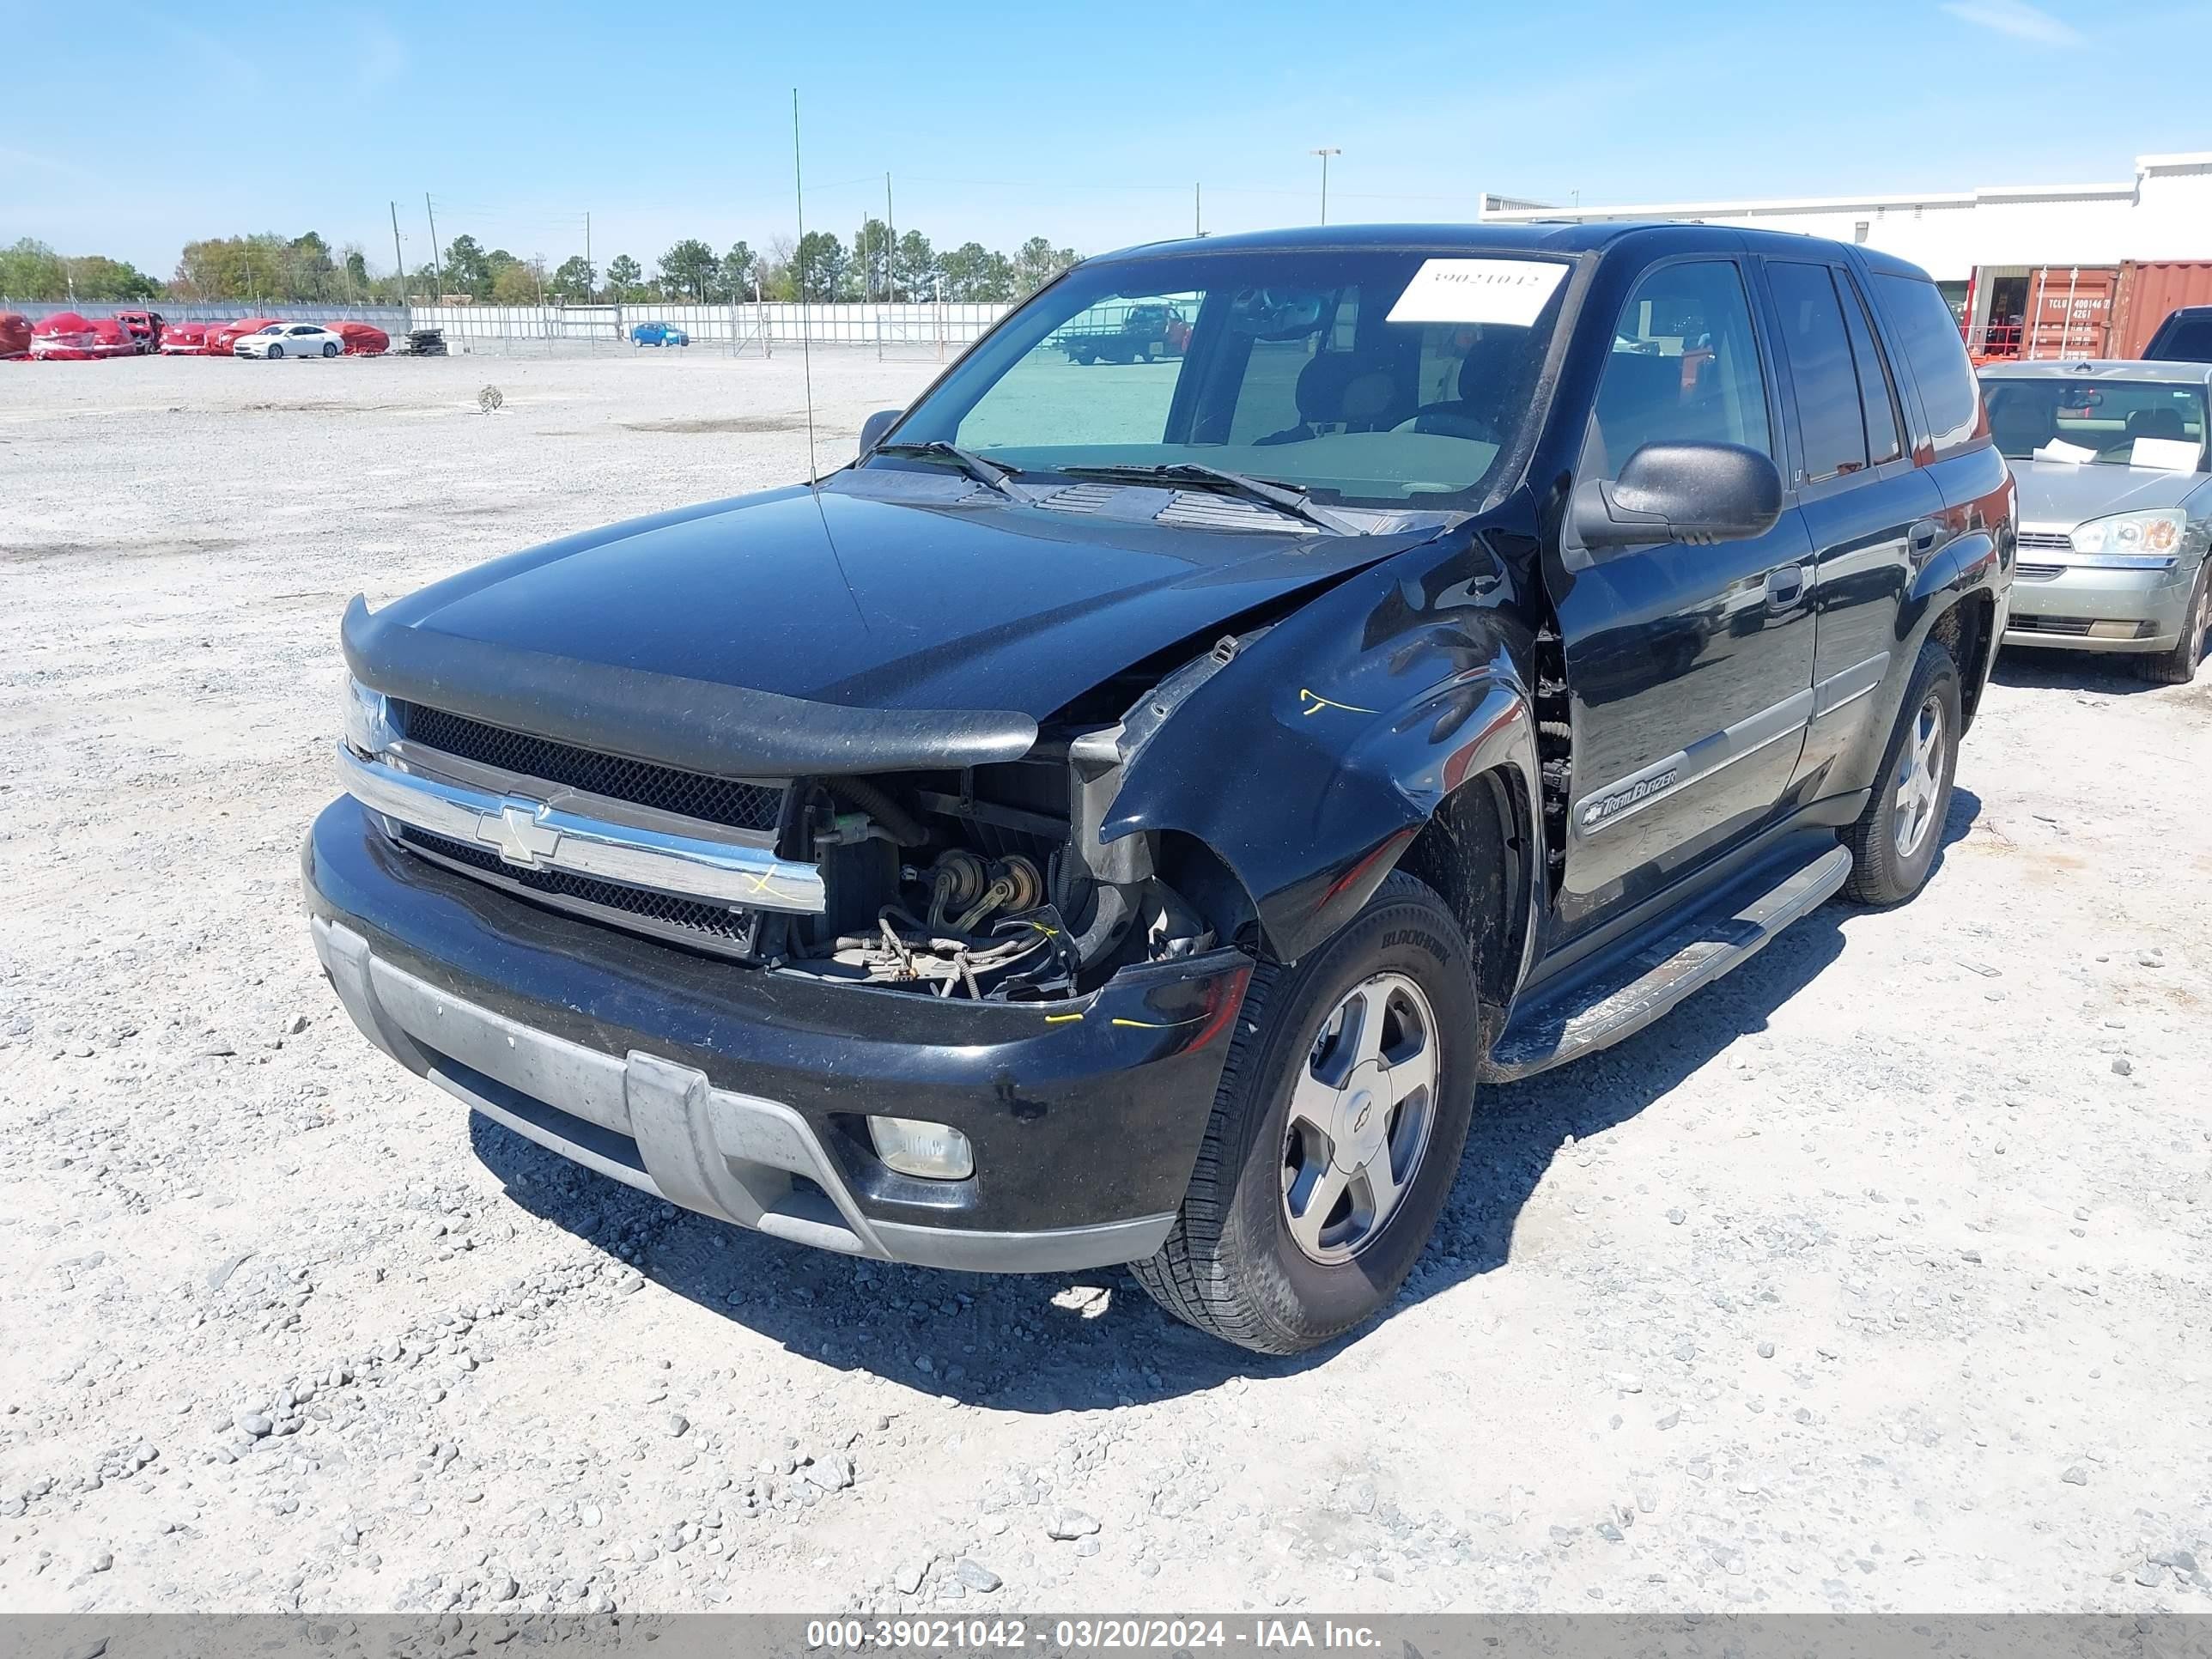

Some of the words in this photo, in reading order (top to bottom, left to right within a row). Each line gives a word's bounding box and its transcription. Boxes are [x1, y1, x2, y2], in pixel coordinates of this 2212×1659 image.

[2049, 299, 2068, 308] TCLU
[2074, 299, 2101, 309] 400146
[2073, 310, 2091, 319] 42G1
